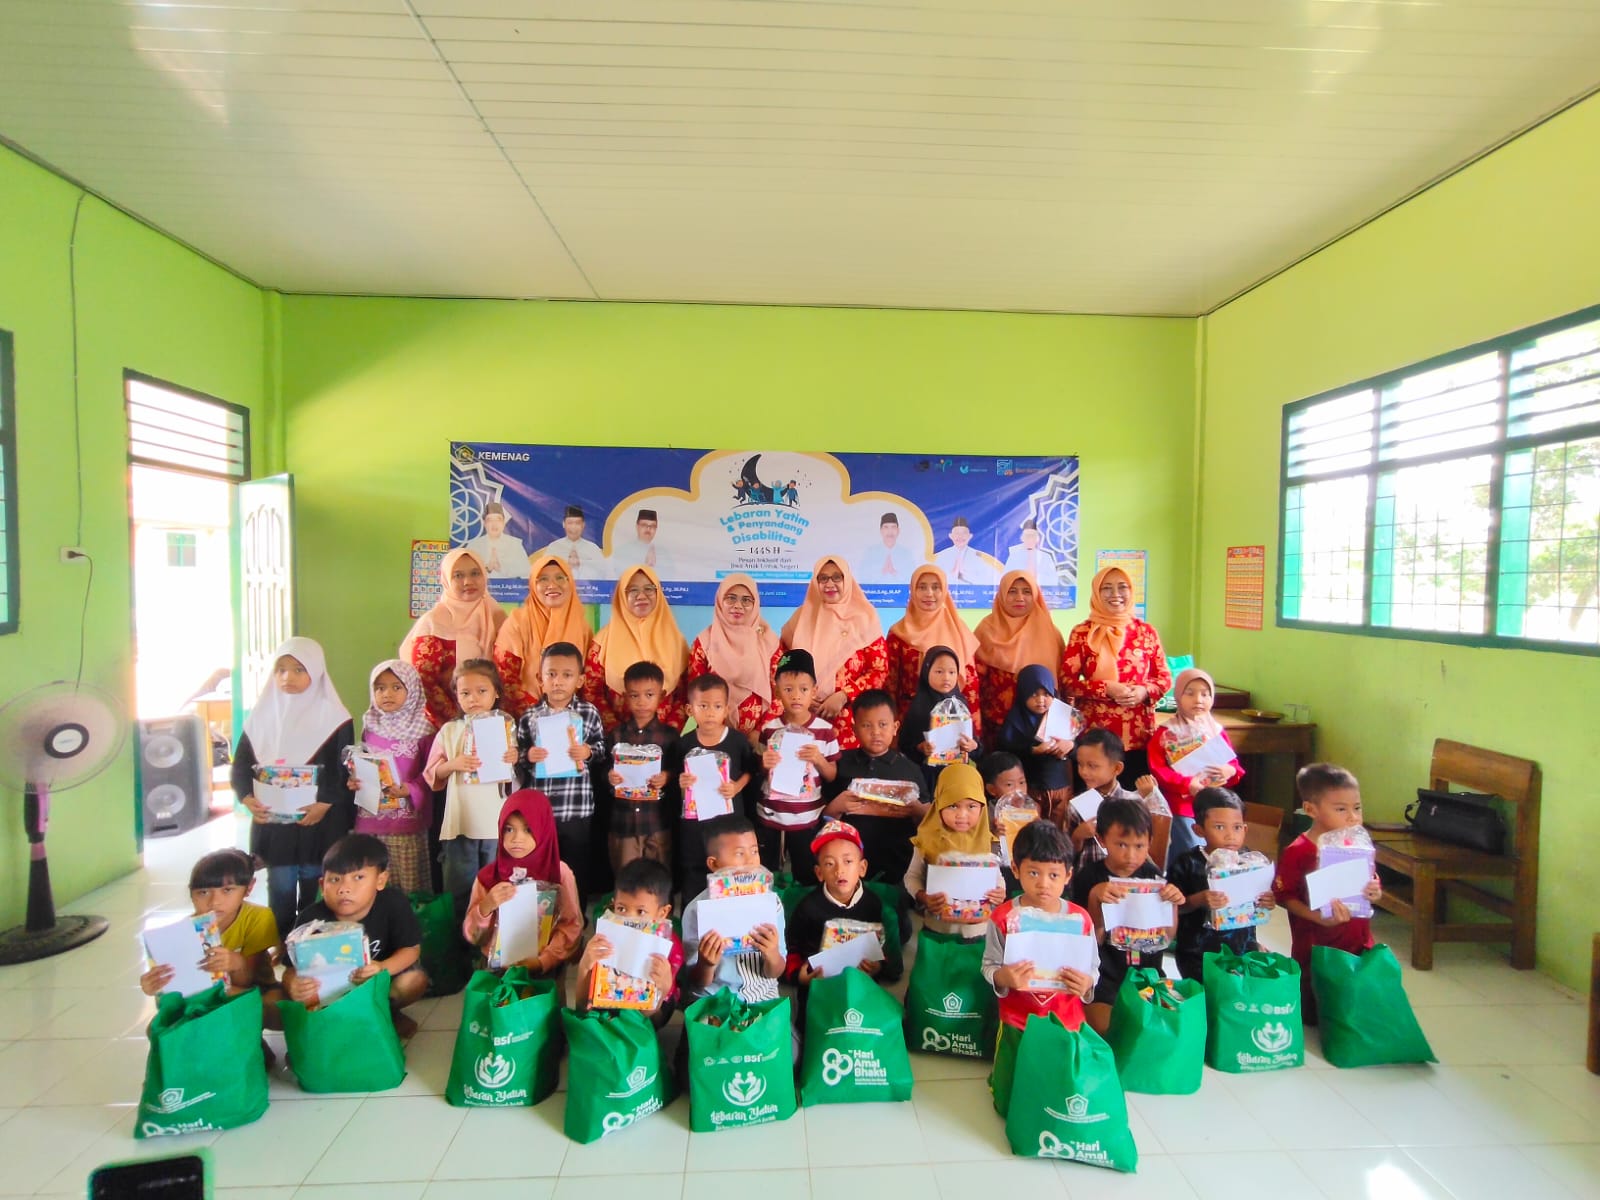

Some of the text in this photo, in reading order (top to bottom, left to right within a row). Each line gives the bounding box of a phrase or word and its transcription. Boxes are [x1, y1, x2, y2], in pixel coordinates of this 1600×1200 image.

[478, 451, 530, 461] KEMENAG
[719, 509, 810, 527] Lebaran Yatim
[738, 520, 804, 536] Penyandang
[732, 531, 797, 545] Disabilitas
[952, 1033, 971, 1042] Hari
[952, 1041, 976, 1050] Amal
[854, 1049, 874, 1059] Hari
[854, 1059, 880, 1067] Amal
[855, 1067, 886, 1077] Bhakti
[1076, 1140, 1100, 1152] Hari
[1076, 1150, 1107, 1160] Amal
